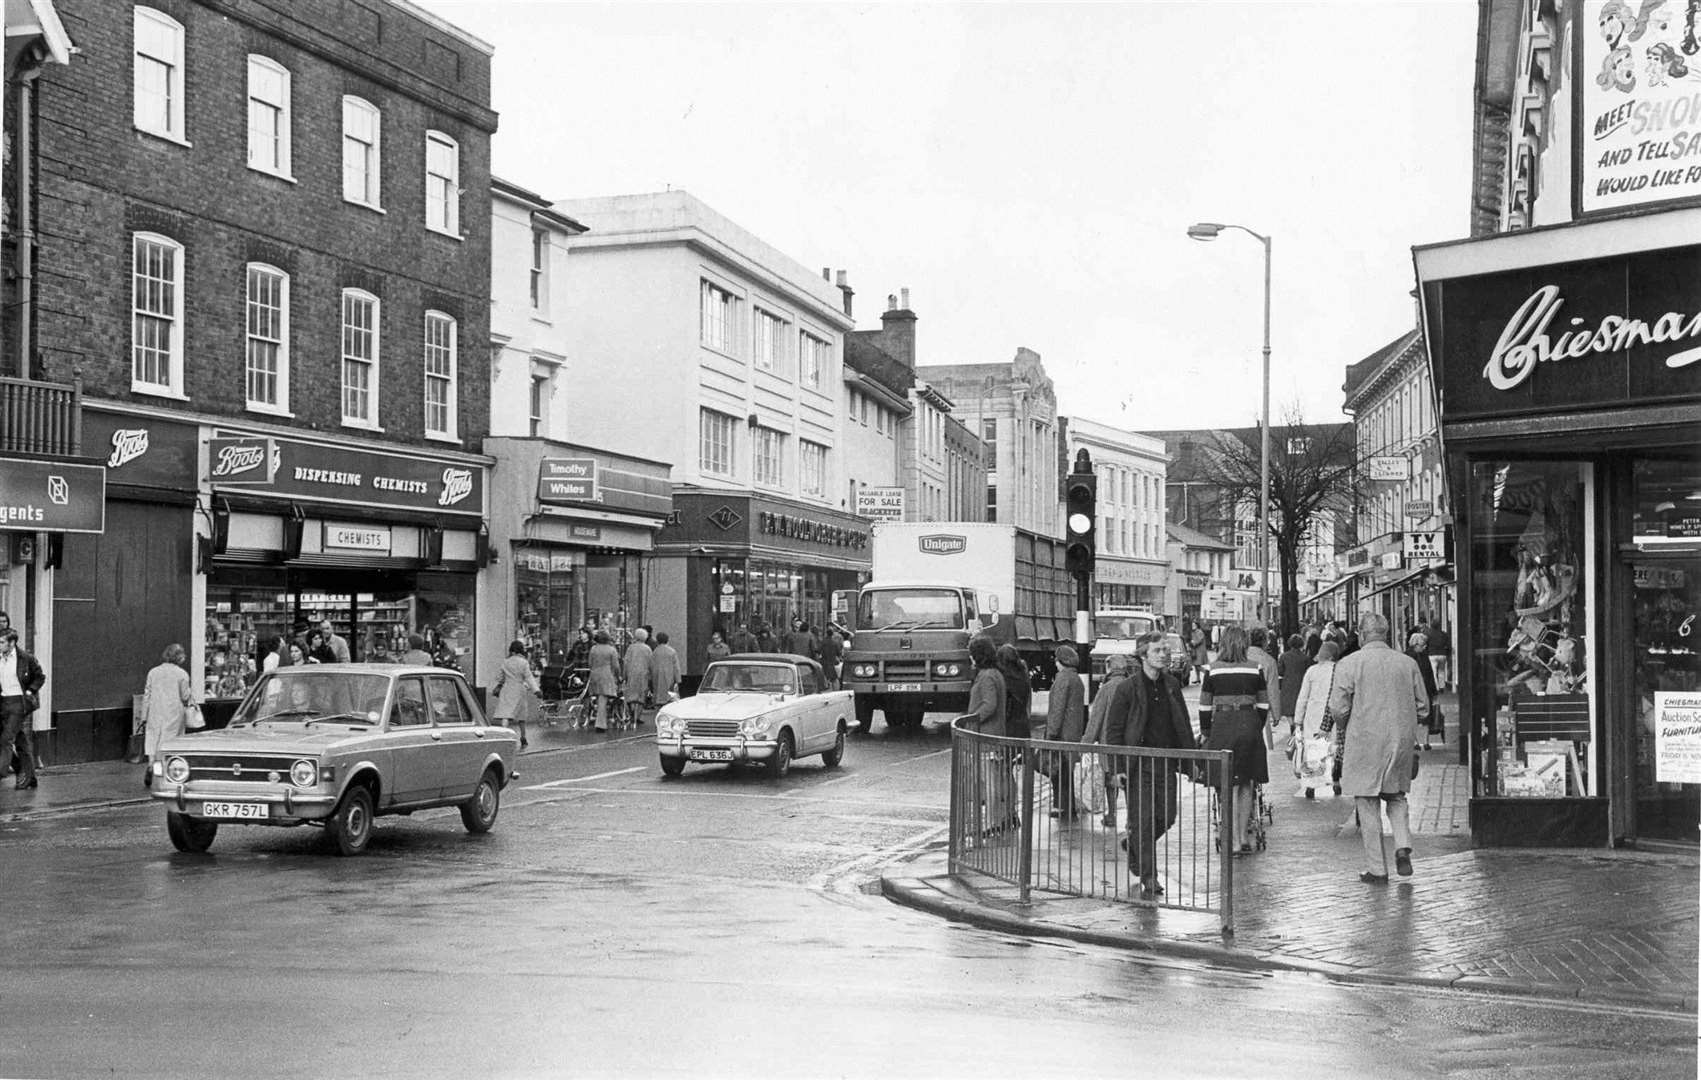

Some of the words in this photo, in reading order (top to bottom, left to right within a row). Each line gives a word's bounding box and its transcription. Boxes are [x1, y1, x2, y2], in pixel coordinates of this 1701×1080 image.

[1594, 100, 1636, 136] MEET
[1598, 148, 1633, 168] AND
[1636, 140, 1670, 161] TELL
[1597, 174, 1649, 196] WOULD
[1651, 168, 1684, 187] LIKE
[108, 429, 149, 467] Boots
[213, 446, 265, 475] Boots
[549, 463, 588, 476] Timothy
[294, 466, 361, 486] DISPENSING
[373, 476, 428, 494] CHEMISTS
[438, 467, 473, 505] Boots
[550, 482, 585, 494] Whites
[859, 498, 876, 506] FOR
[881, 498, 901, 506] SALE
[338, 531, 382, 546] CHEMISTS
[924, 539, 961, 551] Unigate
[1410, 533, 1435, 543] TV
[1661, 710, 1692, 722] Auction
[690, 750, 707, 759] EPL
[205, 803, 230, 815] GKR
[233, 804, 267, 817] 757L
